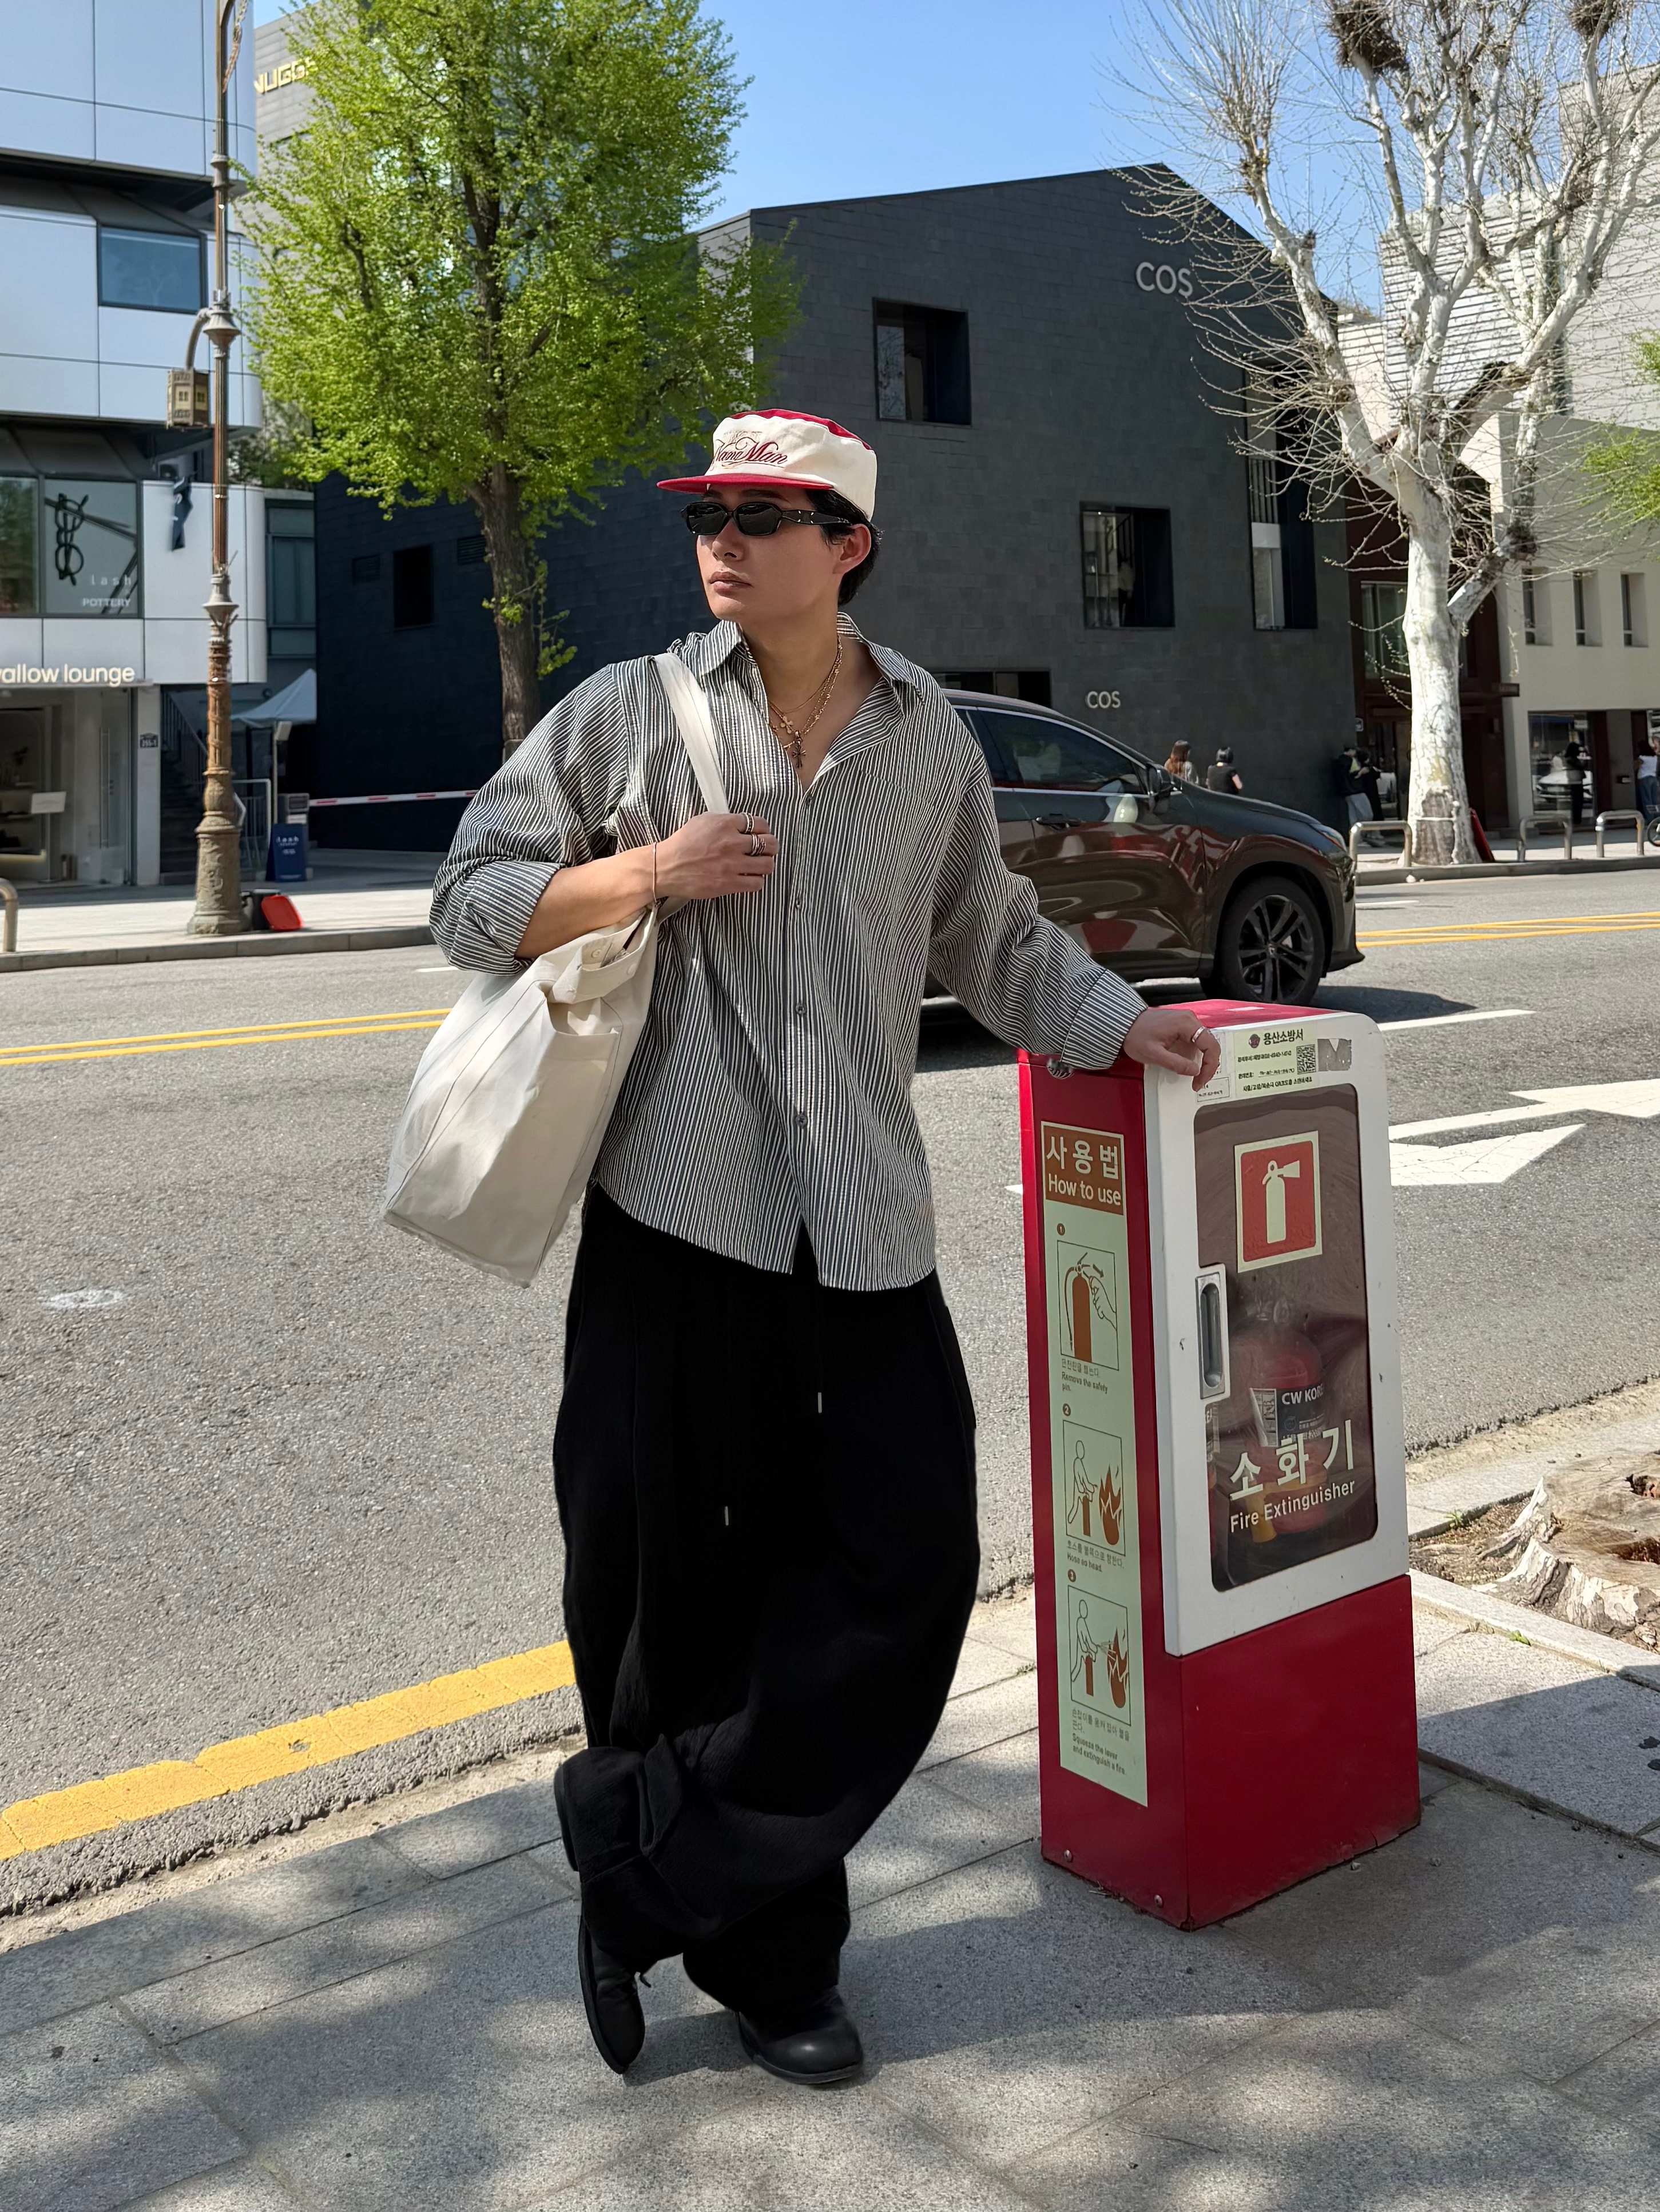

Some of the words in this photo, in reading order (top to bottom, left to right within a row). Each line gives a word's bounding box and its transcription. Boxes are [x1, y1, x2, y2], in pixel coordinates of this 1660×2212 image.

[1135, 262, 1193, 296] COS
[82, 598, 131, 607] POTTERY
[0, 663, 59, 683] allow
[64, 663, 135, 687] lounge
[1086, 691, 1121, 709] COS
[1263, 1028, 1304, 1045] 용산소방서
[1049, 1173, 1077, 1196] How
[1080, 1181, 1094, 1200] to
[1098, 1187, 1122, 1206] use
[1093, 1382, 1108, 1394] safety
[1281, 1391, 1301, 1405] CW
[1230, 1419, 1353, 1501] 소화기
[1230, 1512, 1258, 1533] Fire
[1264, 1480, 1355, 1521] Extinguisher
[1073, 1732, 1094, 1750] Squeeze
[1095, 1743, 1103, 1754] the
[1073, 1745, 1082, 1755] and
